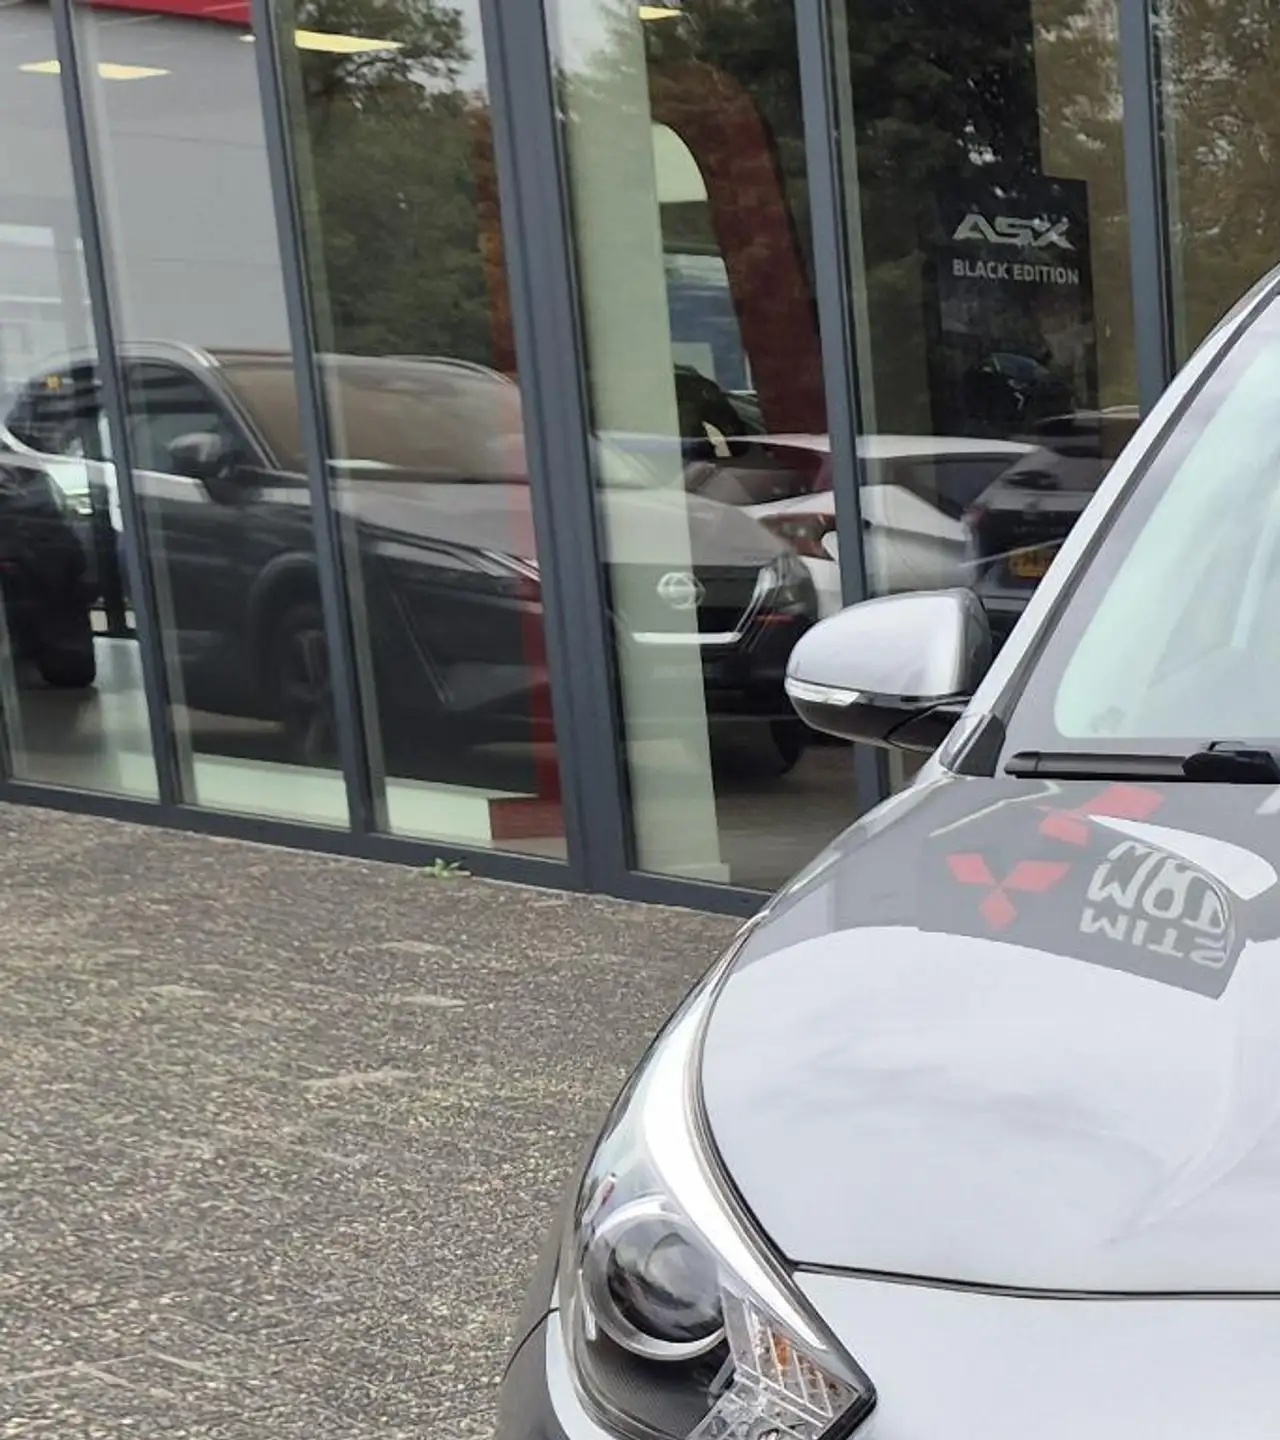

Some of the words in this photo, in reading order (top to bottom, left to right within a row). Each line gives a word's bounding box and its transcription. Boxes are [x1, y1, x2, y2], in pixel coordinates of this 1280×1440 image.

[952, 213, 1075, 250] ASX
[953, 258, 1009, 280] BLACK
[1013, 264, 1080, 285] EDITION
